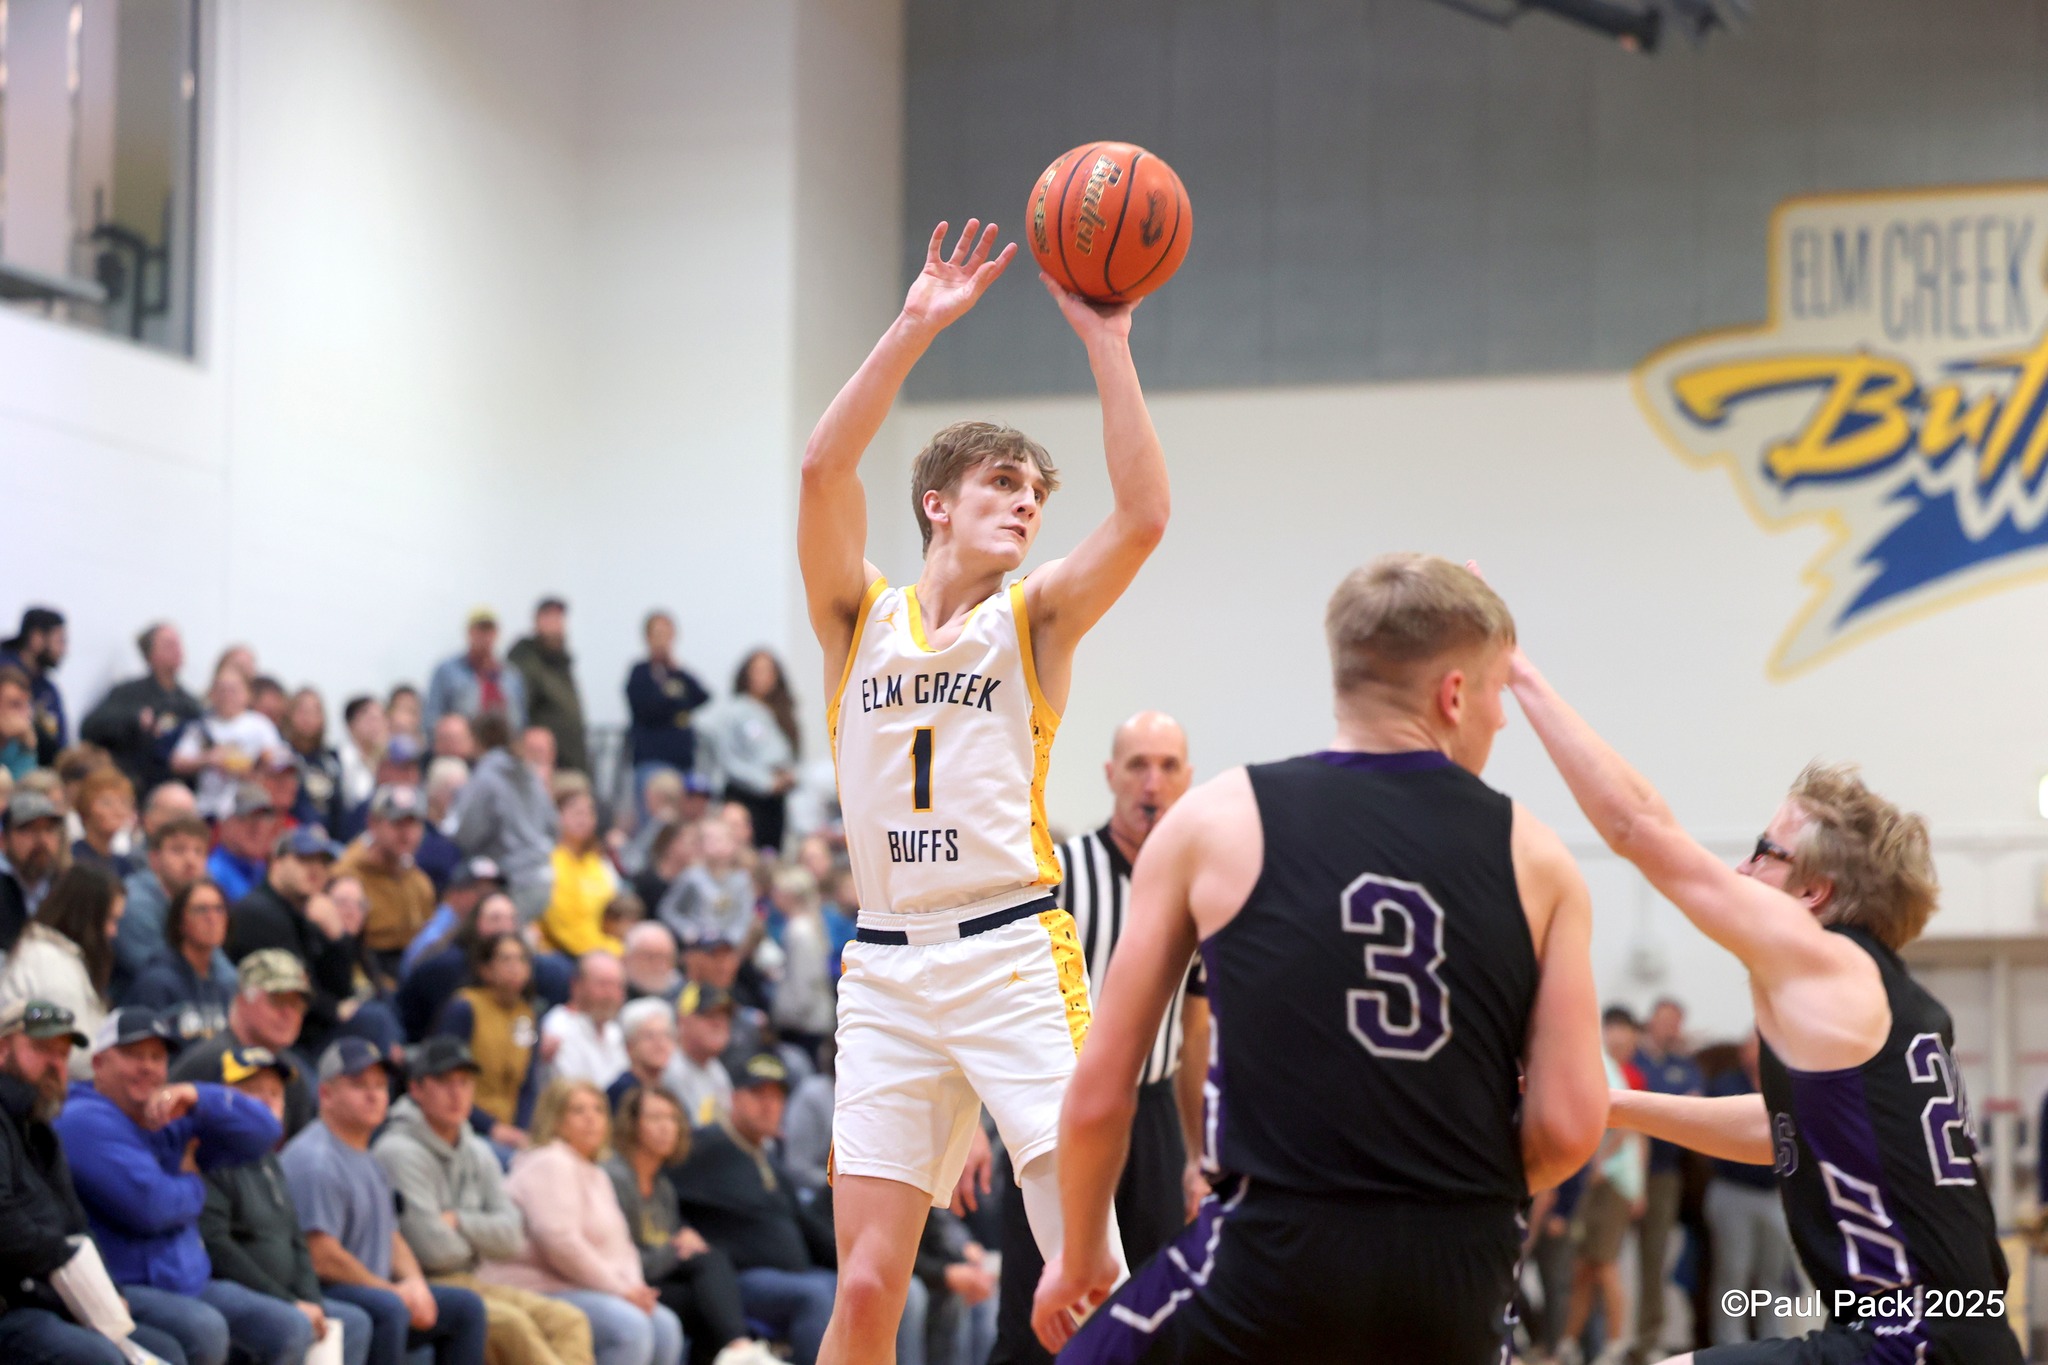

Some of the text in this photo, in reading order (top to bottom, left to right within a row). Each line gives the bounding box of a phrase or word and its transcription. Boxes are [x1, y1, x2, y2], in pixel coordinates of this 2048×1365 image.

[1788, 213, 2035, 342] ELM CREEK
[862, 672, 1002, 713] ELM CREEK
[909, 726, 935, 813] 1
[887, 828, 959, 863] BUFFS
[1340, 872, 1453, 1061] 3
